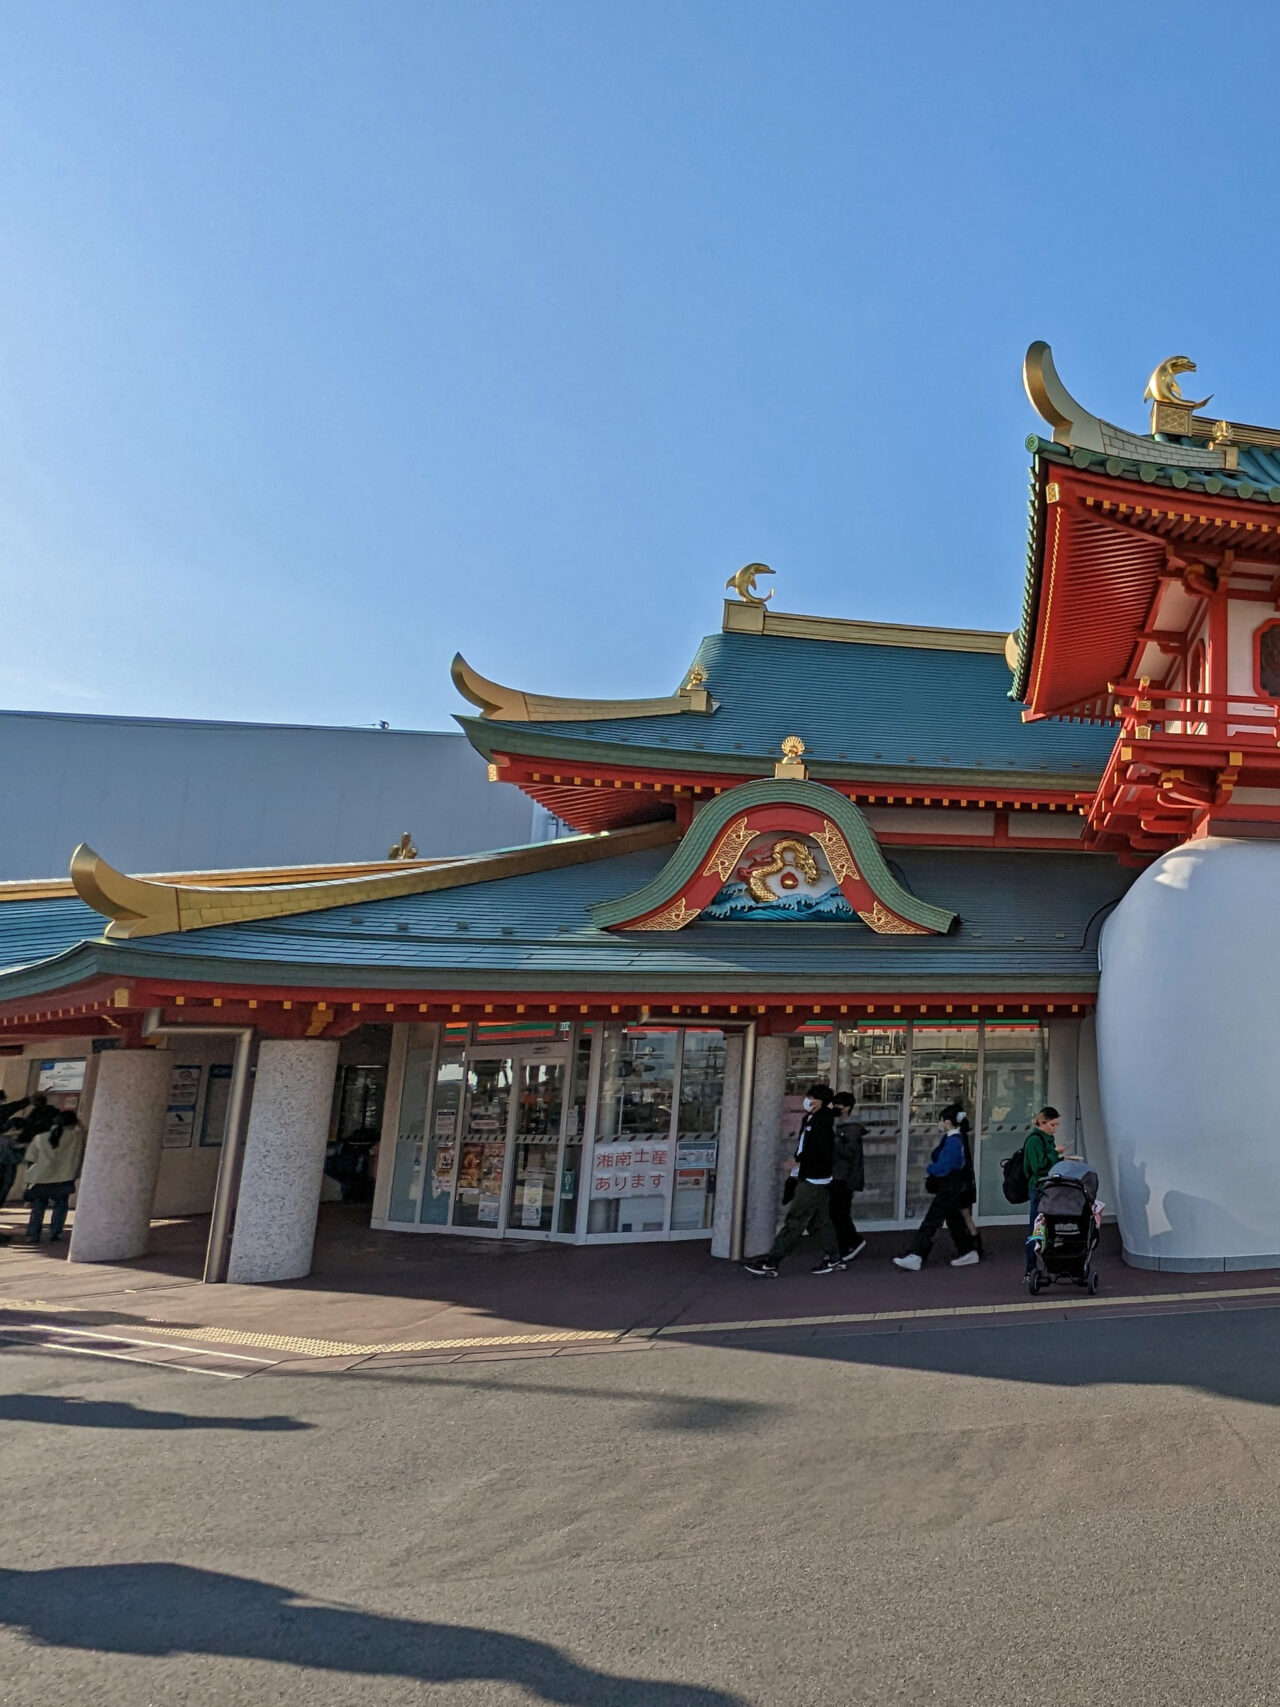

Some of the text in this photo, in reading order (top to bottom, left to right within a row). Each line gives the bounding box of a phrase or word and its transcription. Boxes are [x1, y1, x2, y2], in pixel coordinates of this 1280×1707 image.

[596, 1148, 669, 1169] 湘南土産
[595, 1173, 666, 1192] あります
